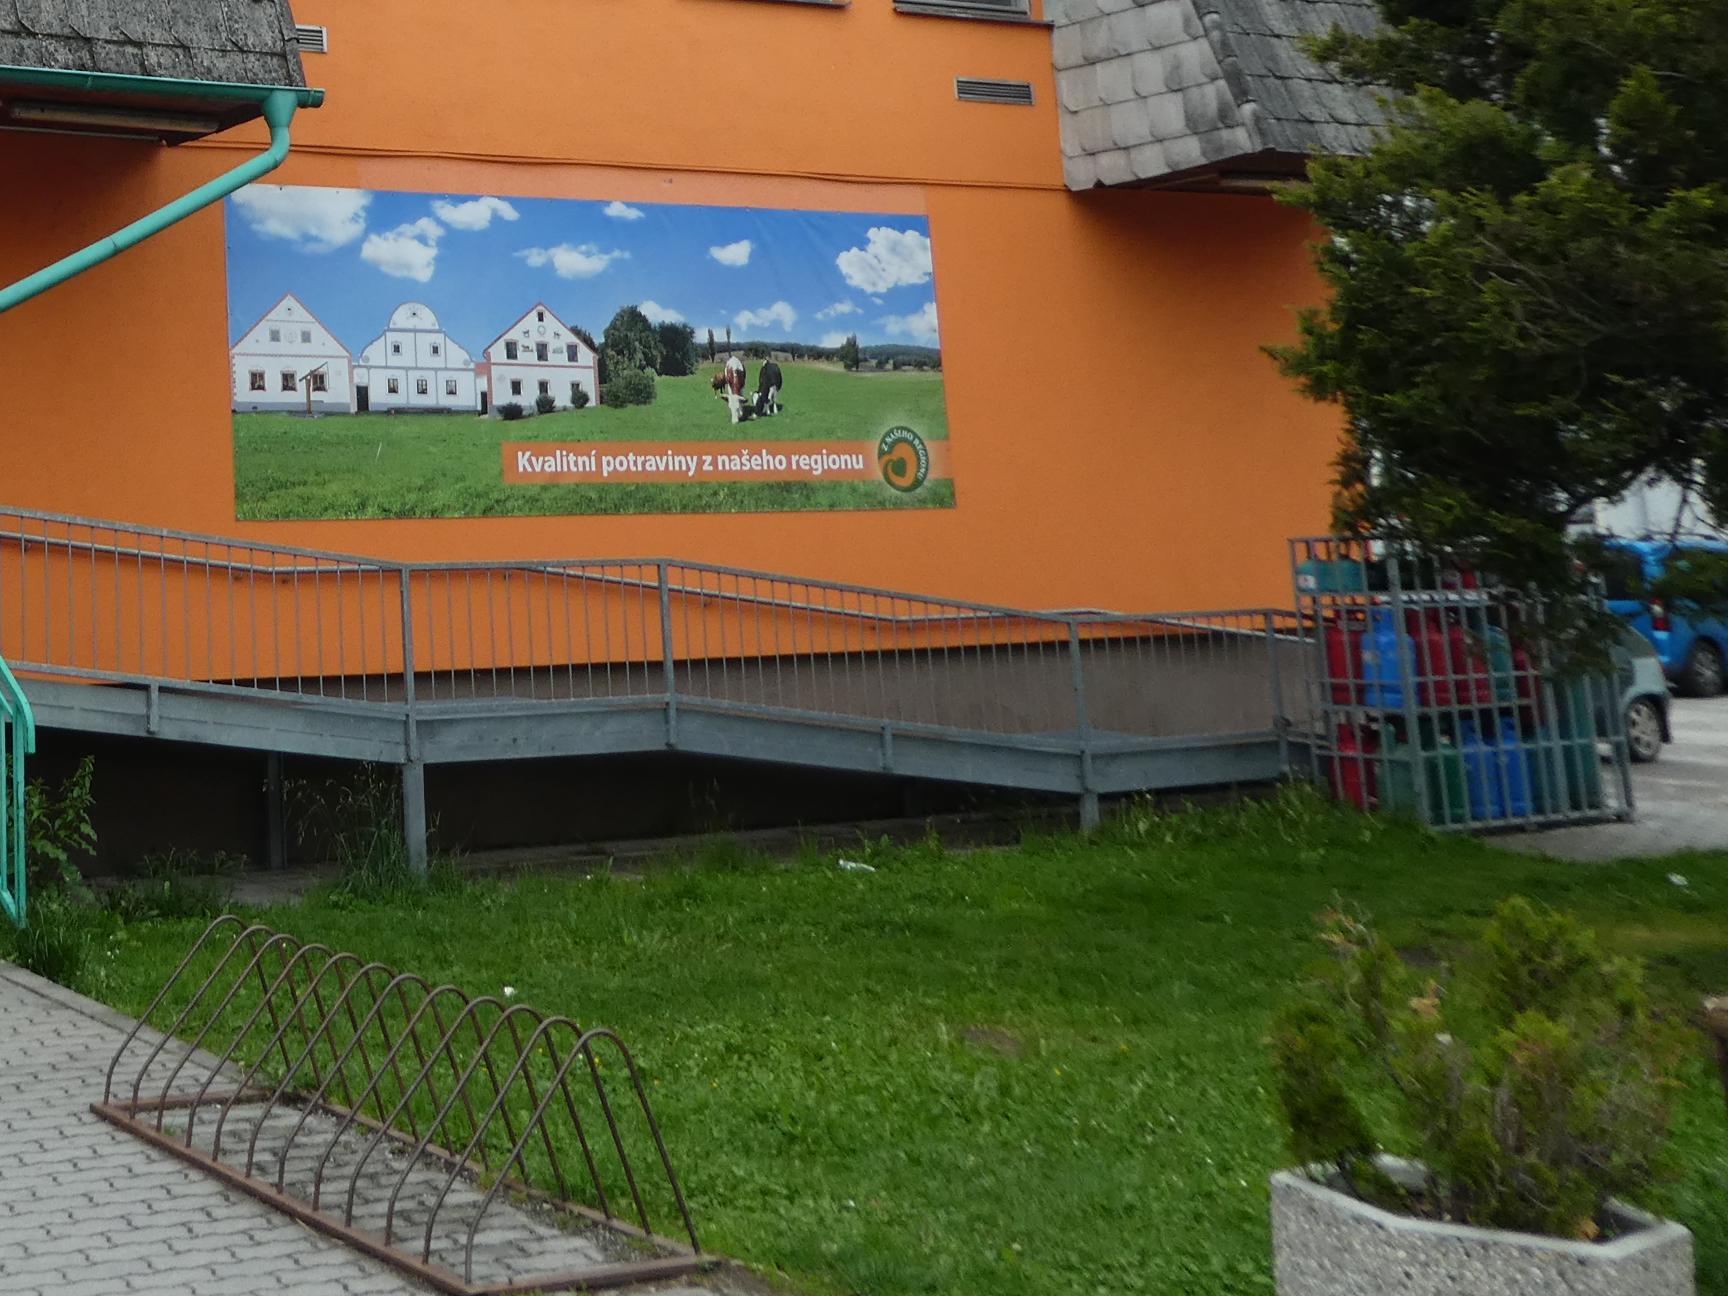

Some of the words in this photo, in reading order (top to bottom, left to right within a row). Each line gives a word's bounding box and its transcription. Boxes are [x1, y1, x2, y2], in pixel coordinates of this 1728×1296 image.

[517, 450, 597, 473] Kvalitní
[601, 450, 698, 477] potraviny
[702, 454, 713, 471] z
[718, 448, 787, 471] našeho
[791, 449, 864, 476] regionu
